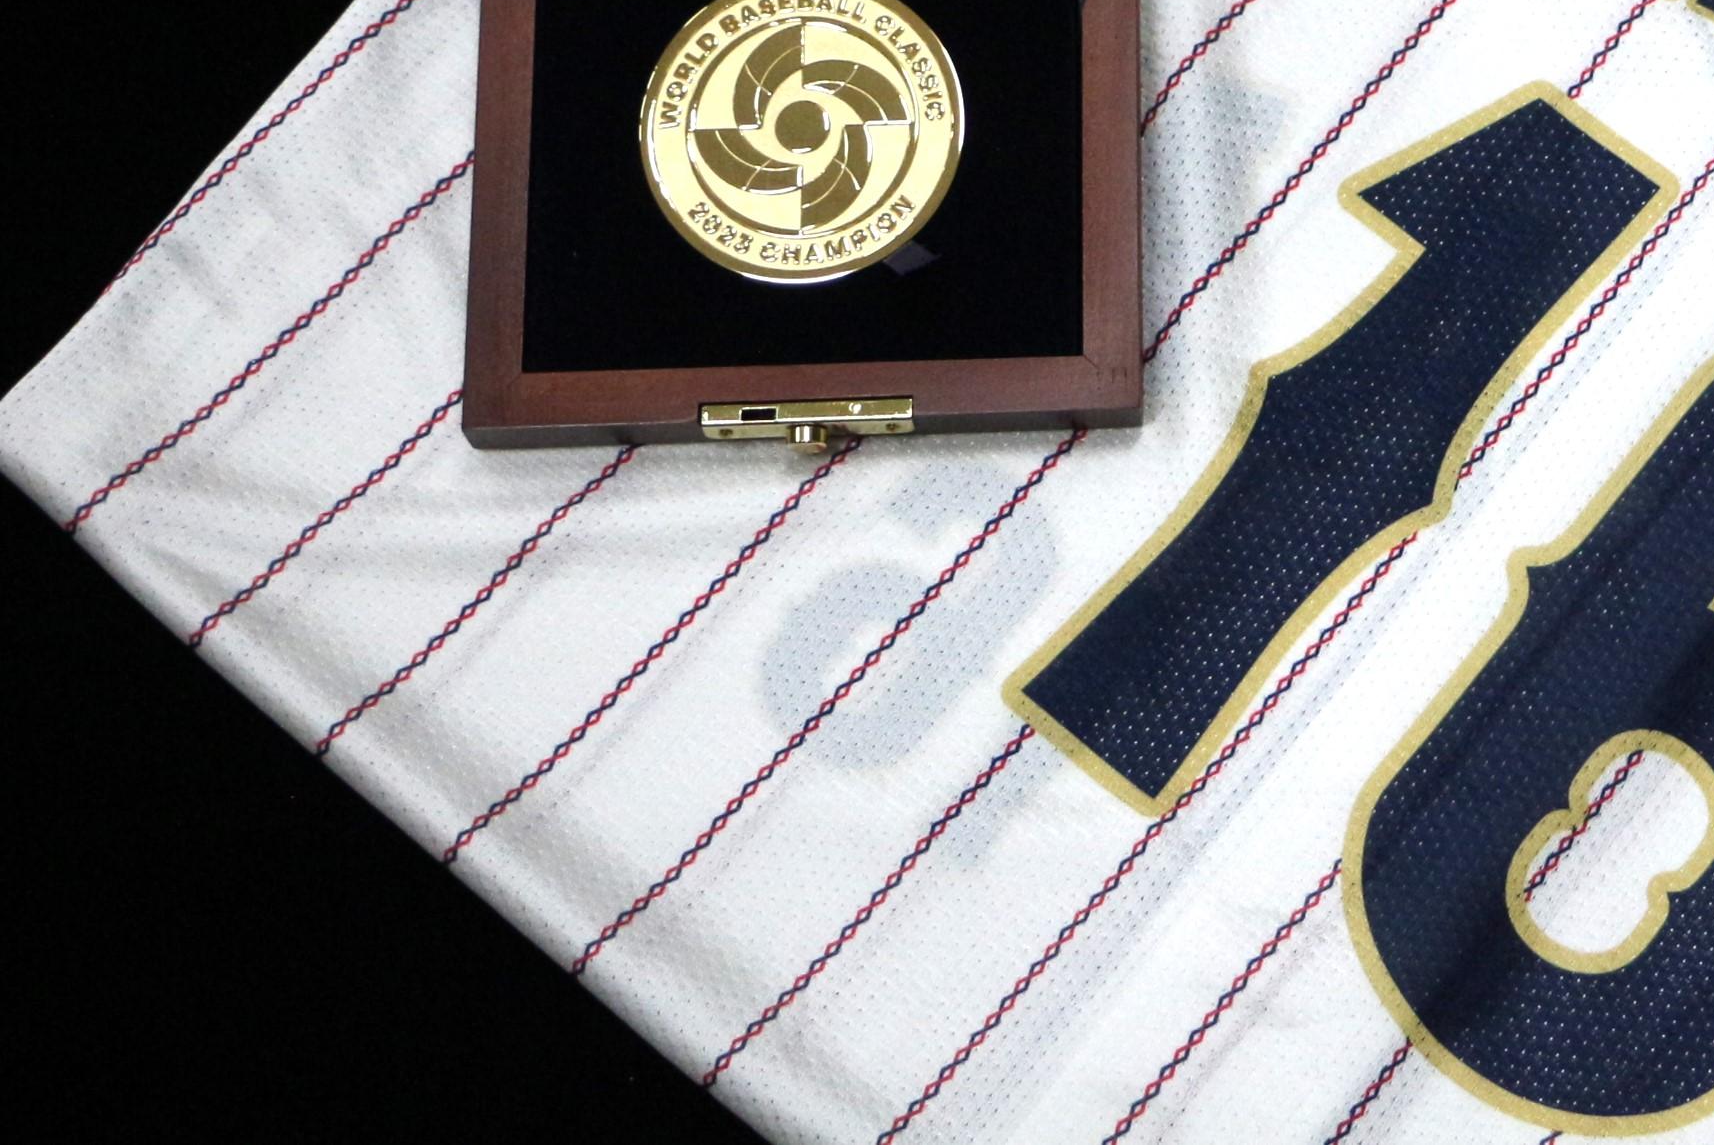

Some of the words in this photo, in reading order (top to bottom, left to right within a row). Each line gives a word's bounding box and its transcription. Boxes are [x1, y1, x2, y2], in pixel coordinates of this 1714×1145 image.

[658, 31, 720, 130] WORLD
[874, 14, 946, 123] CLASSIC
[687, 201, 755, 255] 2023
[758, 194, 917, 266] CHAMPION
